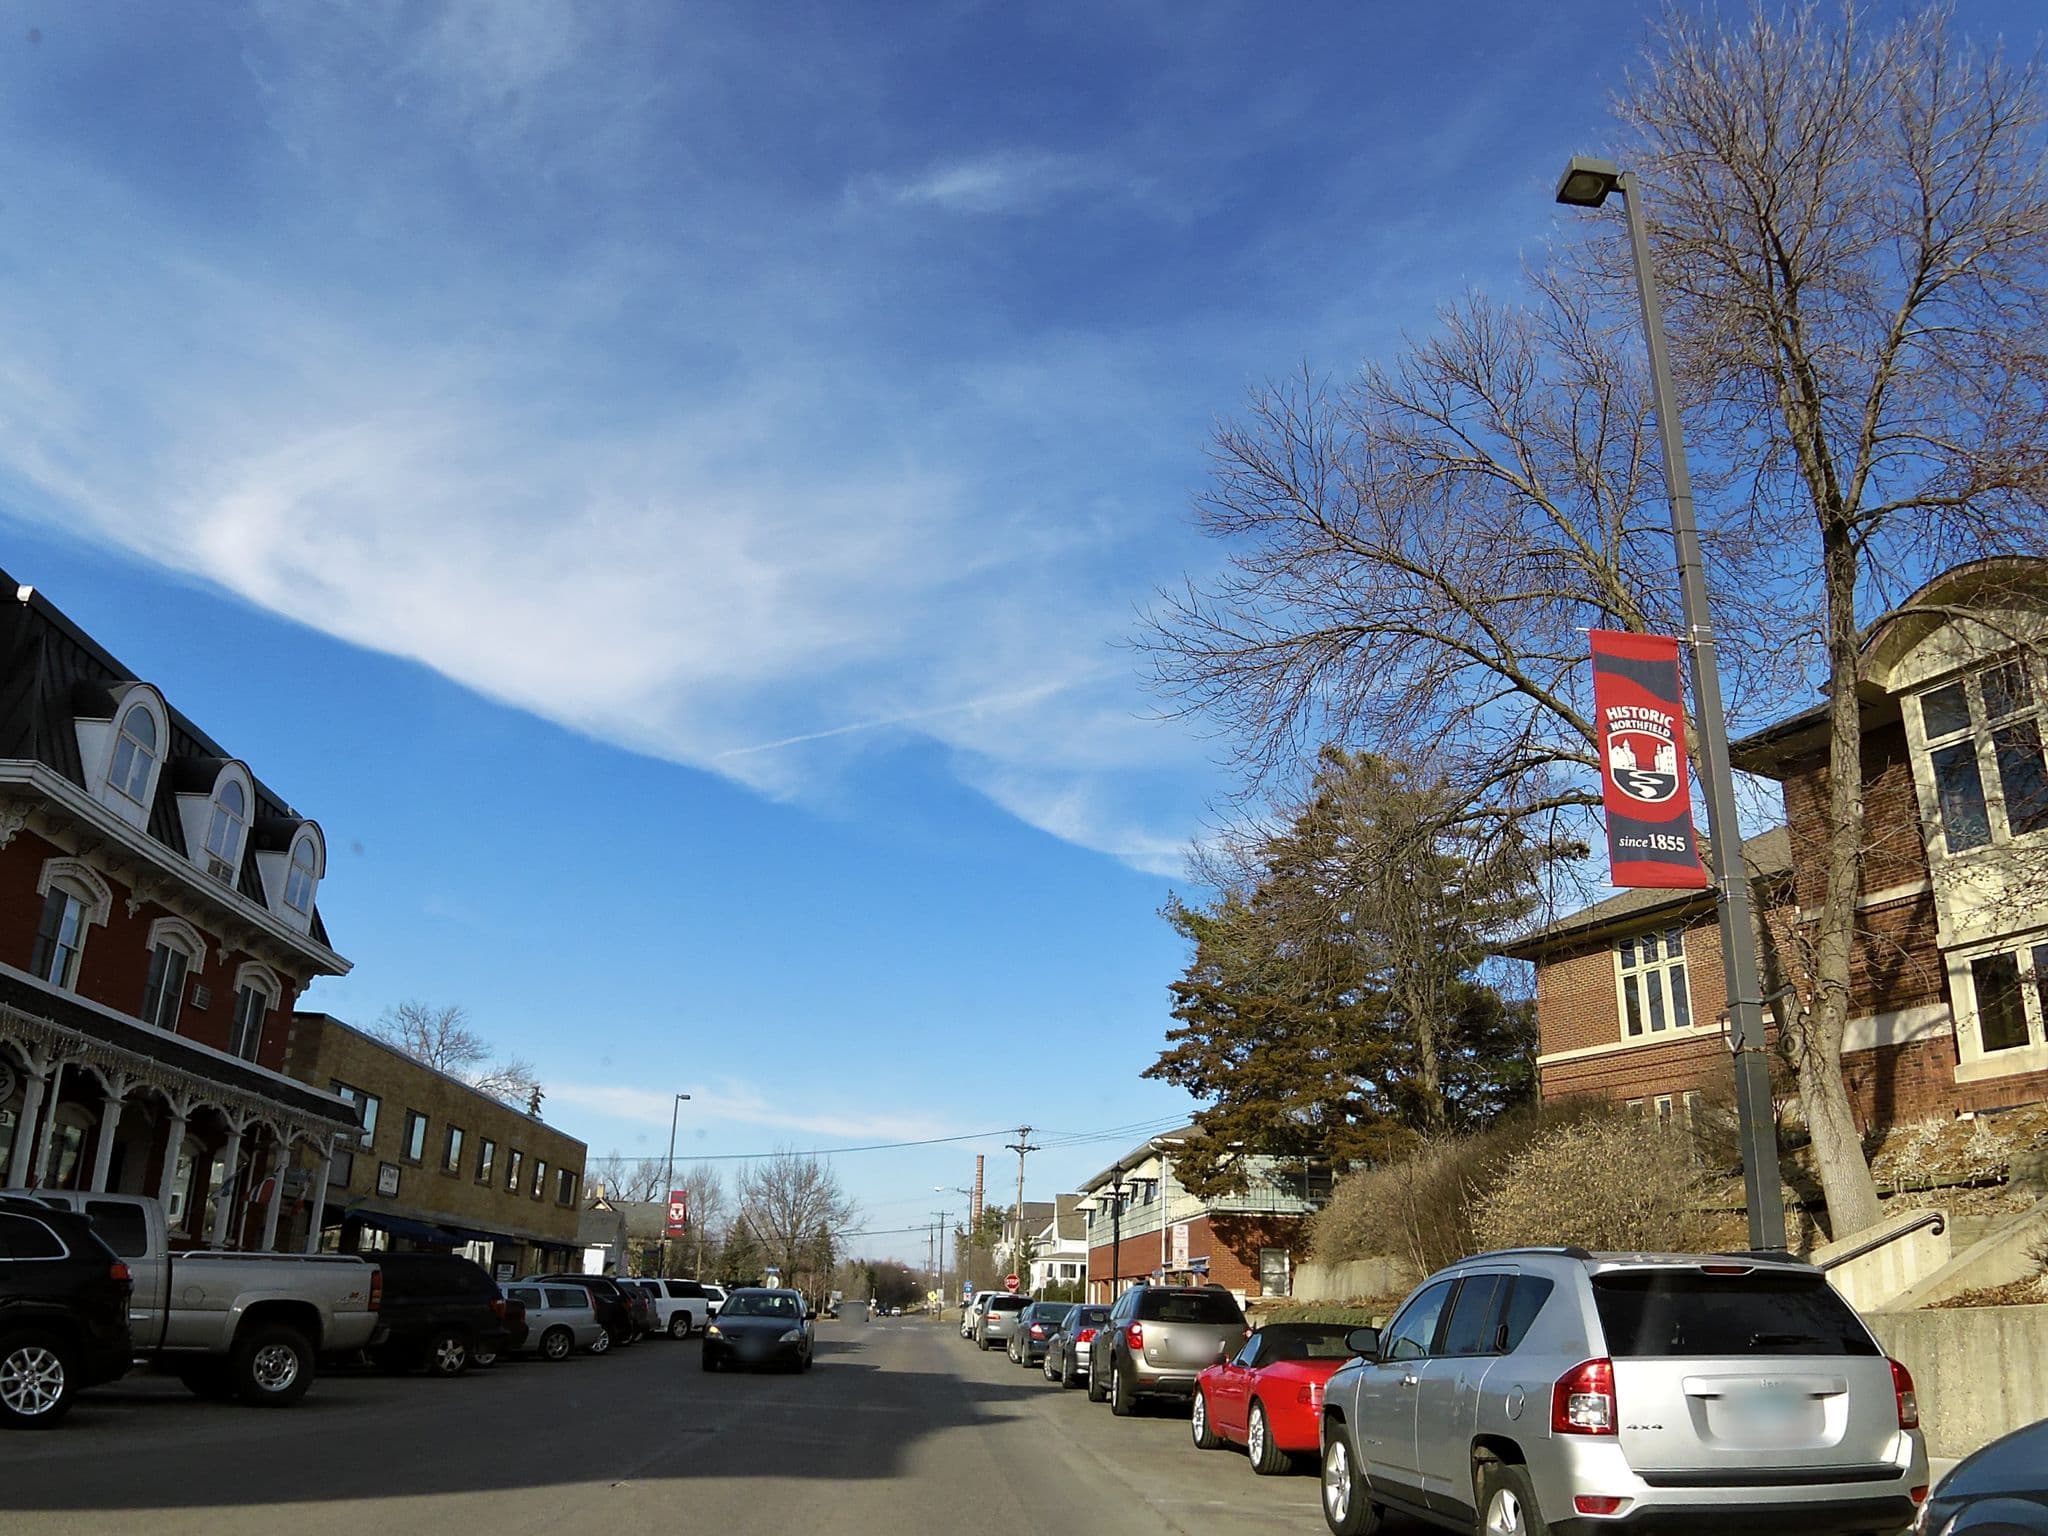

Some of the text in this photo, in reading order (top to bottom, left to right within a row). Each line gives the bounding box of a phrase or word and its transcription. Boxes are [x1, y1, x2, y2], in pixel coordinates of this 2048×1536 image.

[1605, 706, 1674, 729] HISTORIC
[1609, 719, 1671, 738] NORTHFIELD
[1619, 833, 1686, 852] since 1855
